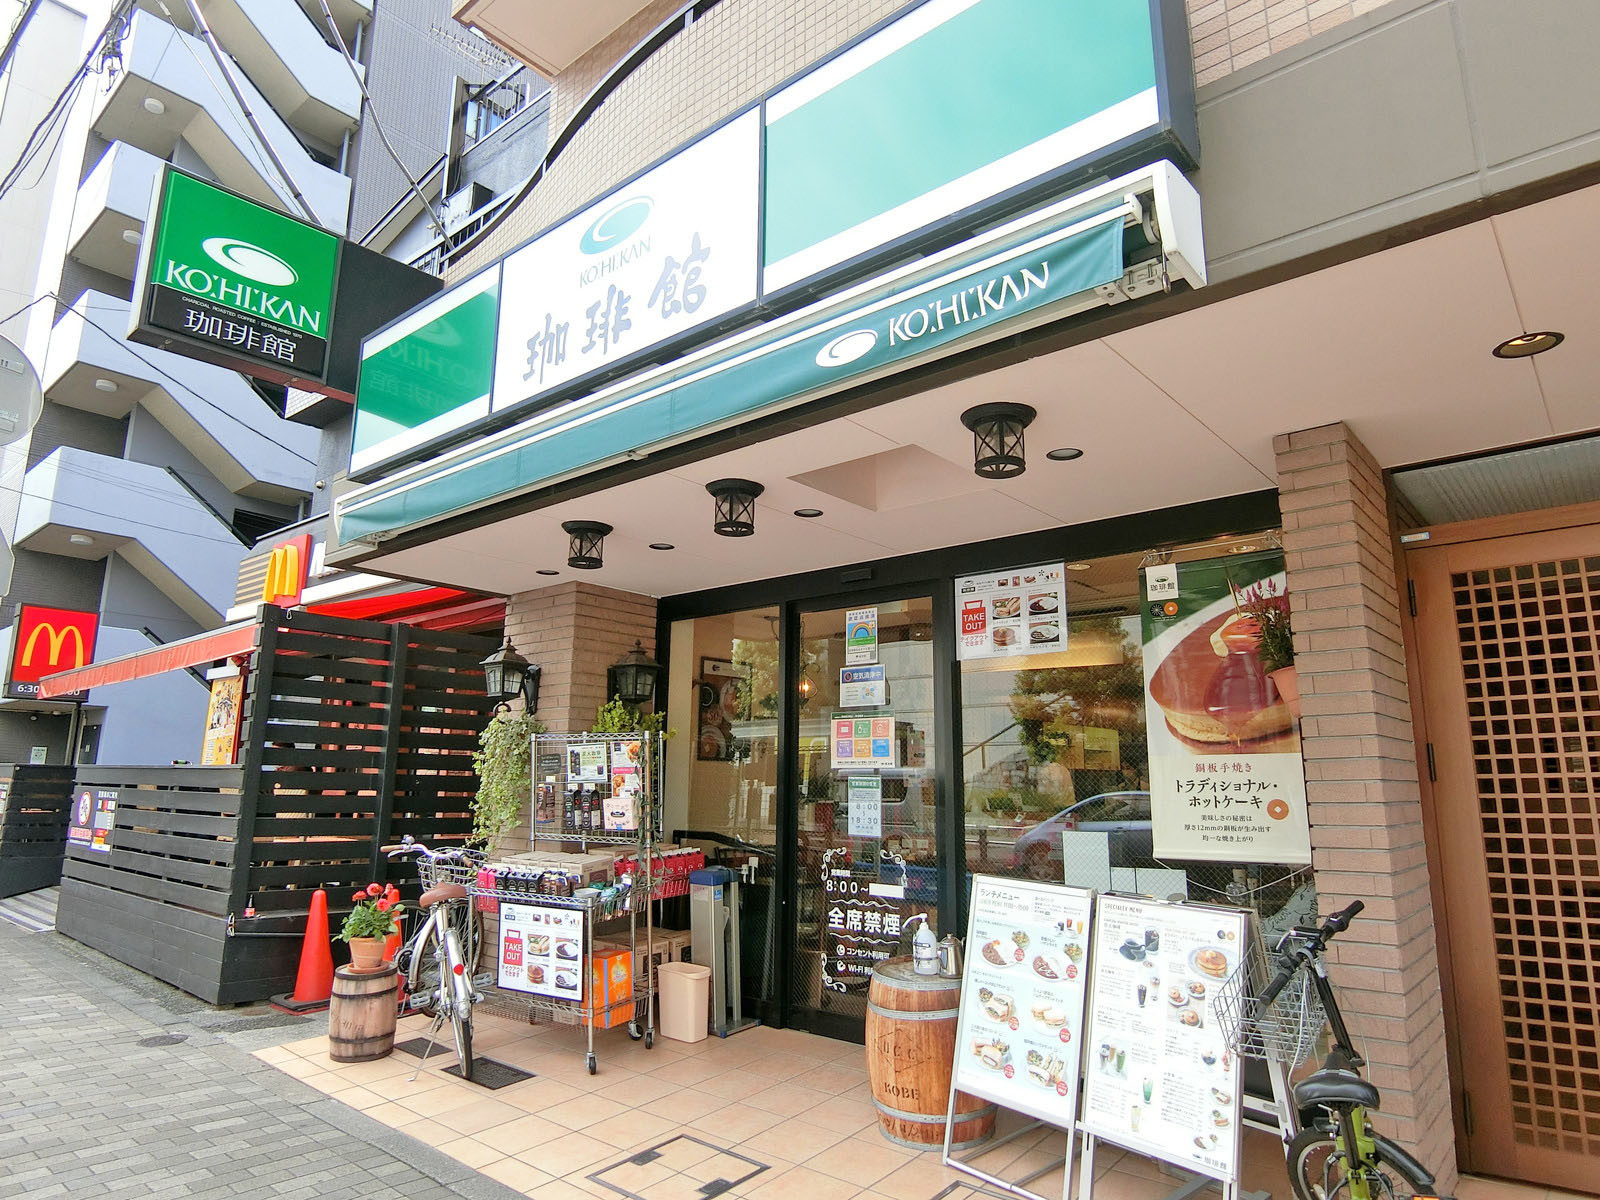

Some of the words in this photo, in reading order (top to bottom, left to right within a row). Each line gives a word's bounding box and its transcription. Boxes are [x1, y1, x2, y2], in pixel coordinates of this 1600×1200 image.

[182, 296, 210, 309] CHARCOAL
[212, 306, 236, 318] ROASTED
[237, 314, 256, 324] COFFEE
[522, 232, 711, 384] 珈琲館
[184, 308, 297, 362] 珈琲館
[963, 612, 984, 622] TAKE
[966, 622, 982, 630] OUT
[1195, 762, 1252, 773] 銅板手焼き
[1189, 795, 1263, 809] ホットケーキ
[1202, 814, 1252, 822] 美味しさの秘密は
[828, 907, 900, 936] 全席禁煙
[505, 942, 522, 951] TAKE
[506, 952, 520, 960] OUT
[884, 1082, 920, 1100] KOBE
